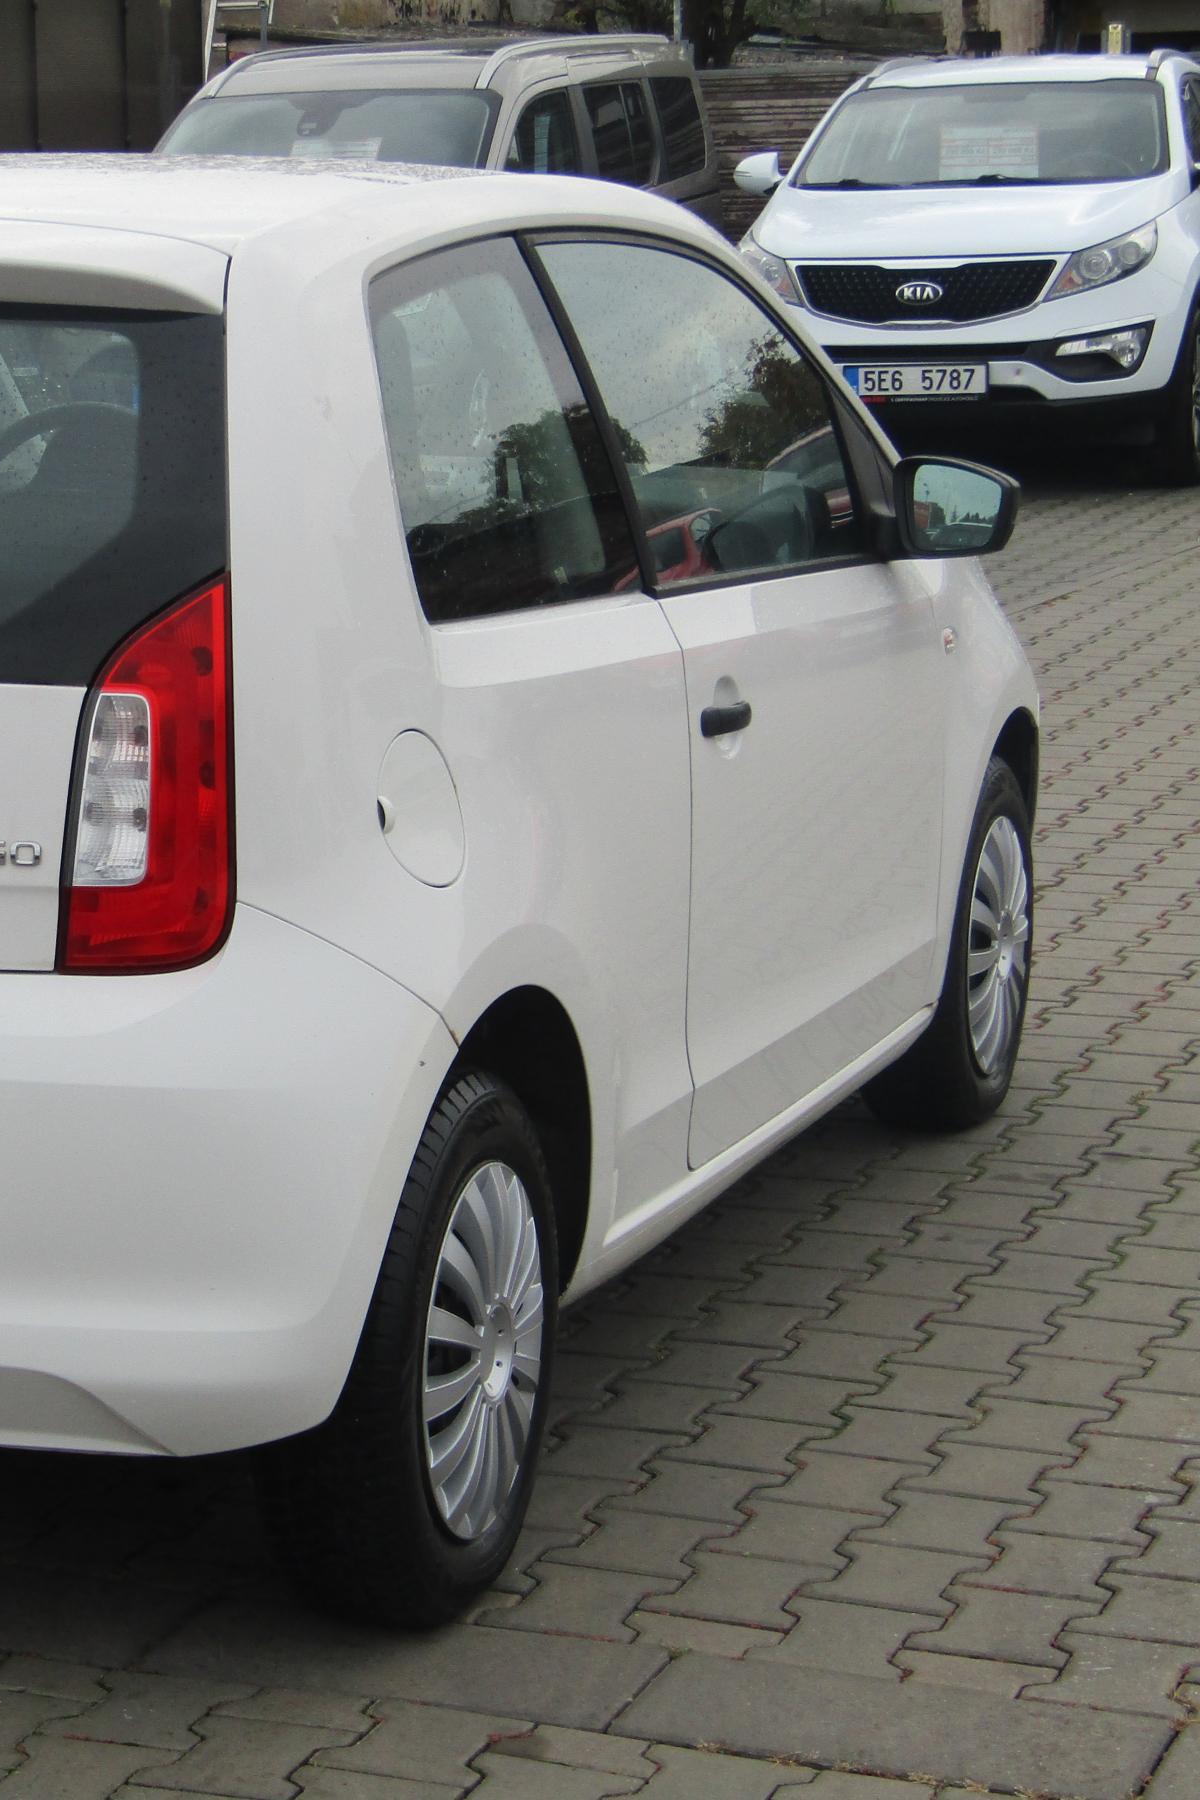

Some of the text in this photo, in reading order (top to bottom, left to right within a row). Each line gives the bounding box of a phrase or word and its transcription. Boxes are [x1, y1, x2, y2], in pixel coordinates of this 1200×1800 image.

[902, 285, 935, 301] KIA
[863, 368, 975, 392] 5E6 5787
